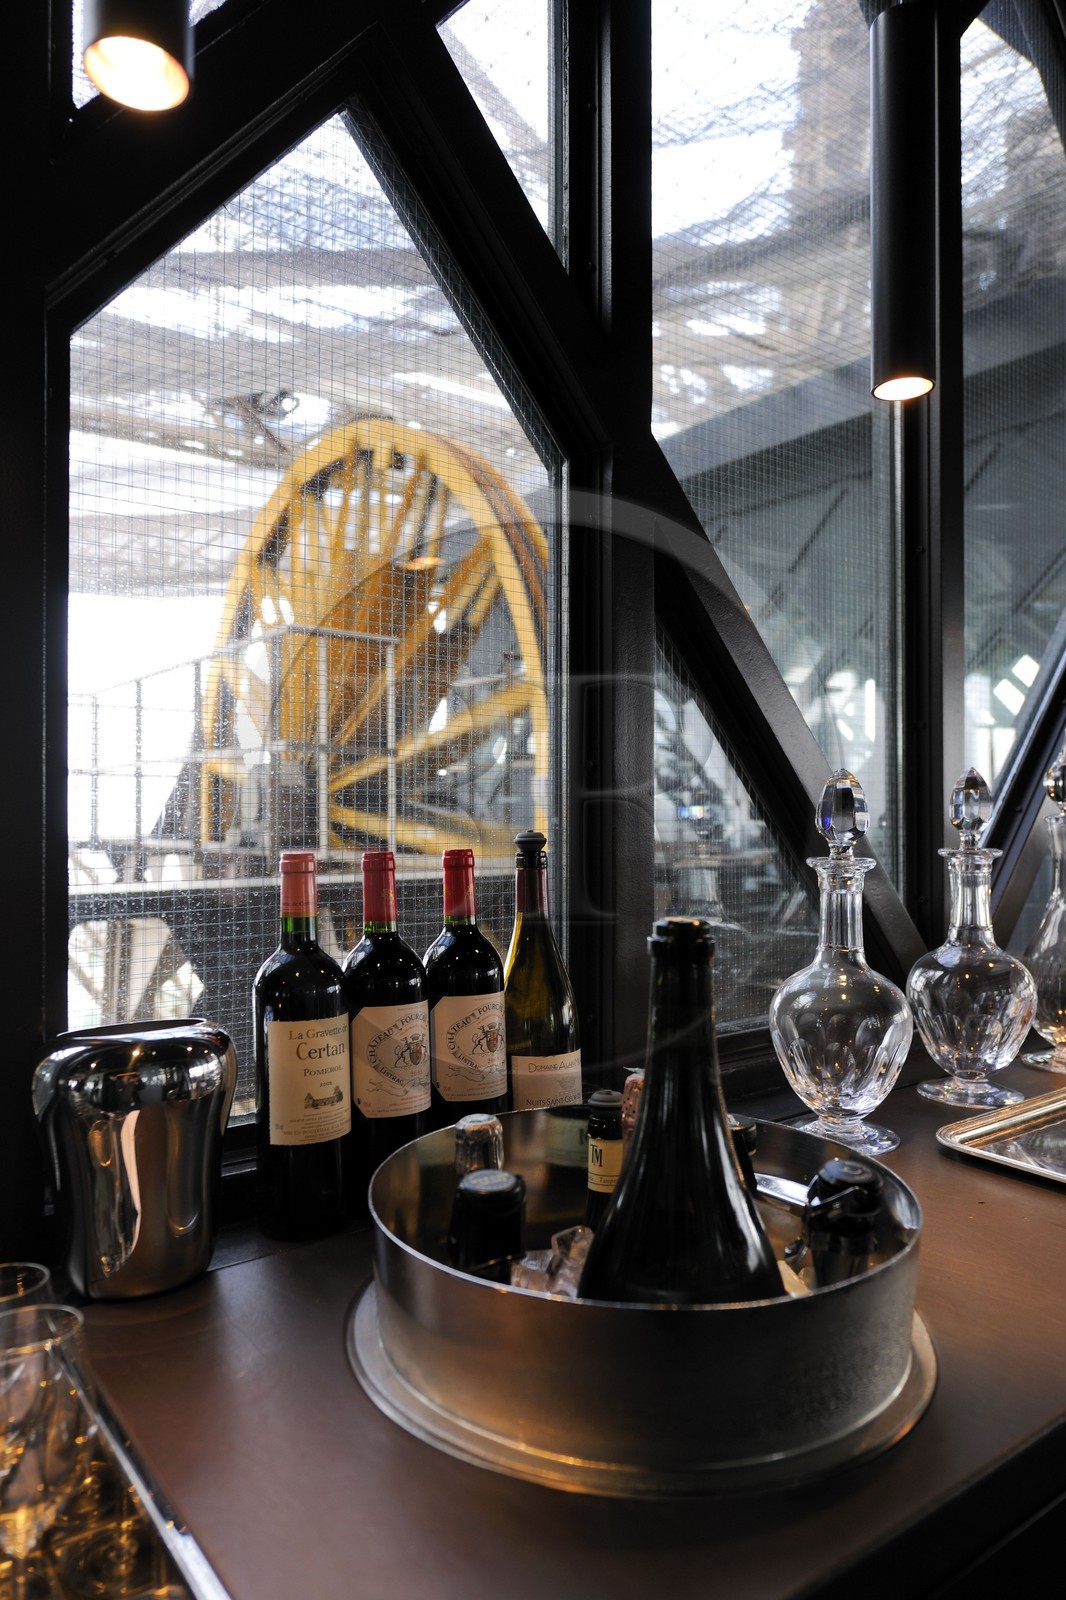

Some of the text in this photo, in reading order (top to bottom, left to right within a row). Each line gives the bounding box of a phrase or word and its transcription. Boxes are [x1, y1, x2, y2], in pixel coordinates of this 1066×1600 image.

[289, 1030, 303, 1040] La
[306, 1026, 341, 1039] Gravette
[296, 1042, 345, 1061] Certan
[457, 1053, 481, 1070] LISTRAC
[528, 1062, 558, 1073] DOMAINE
[304, 1066, 343, 1077] POMEROL
[379, 1067, 404, 1084] LISTRAC
[546, 1097, 564, 1105] SAINT
[590, 1143, 603, 1167] TM
